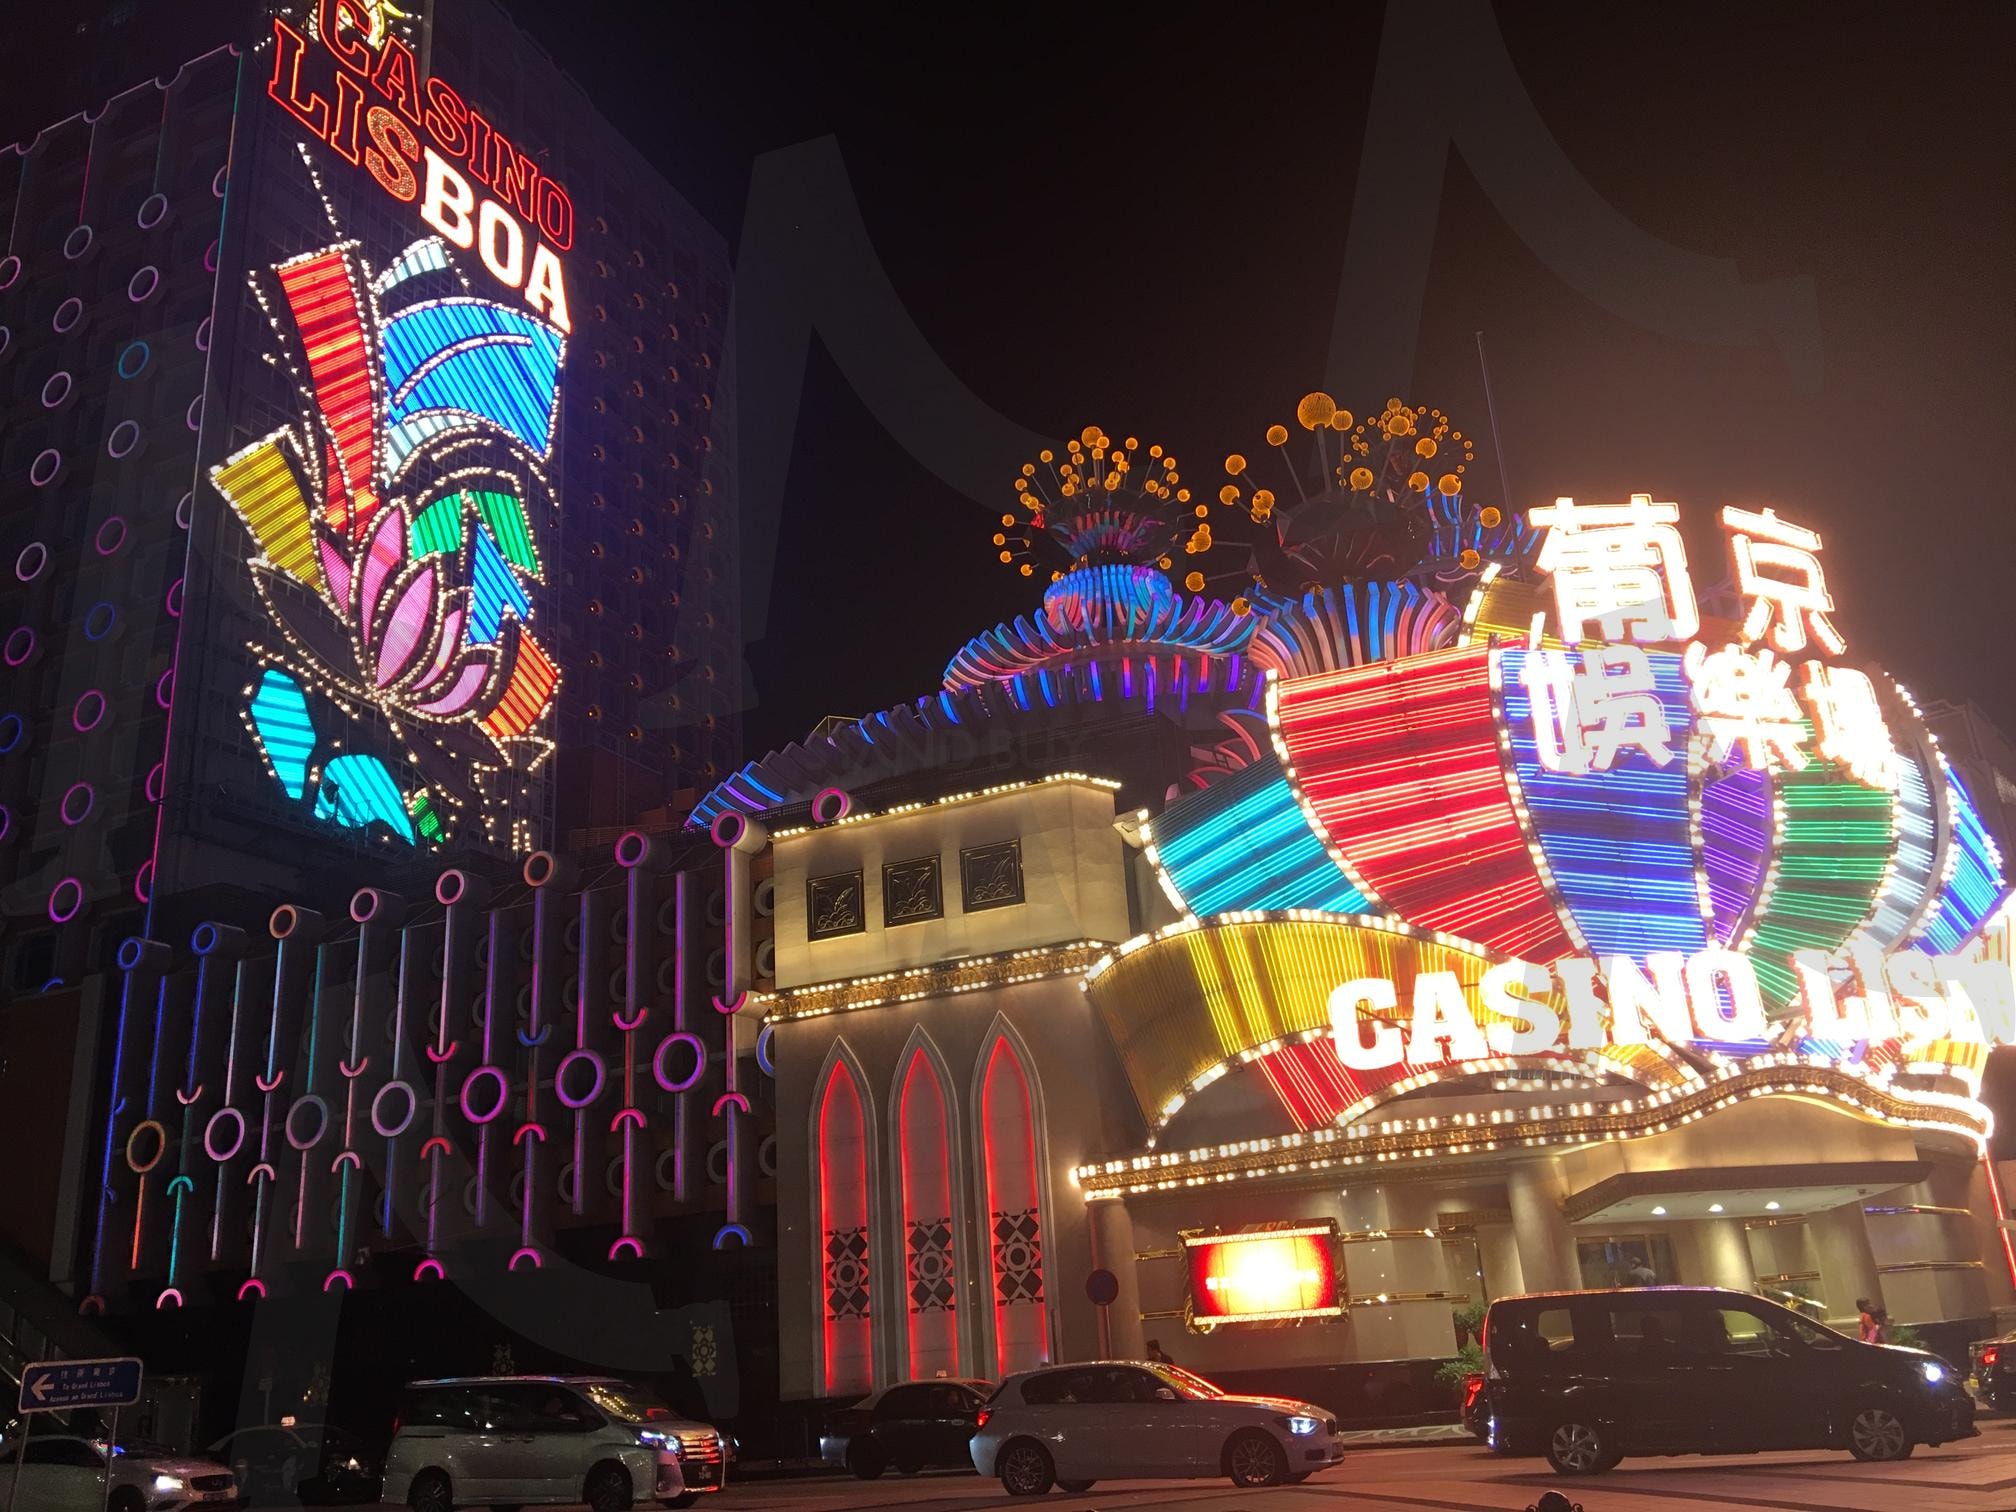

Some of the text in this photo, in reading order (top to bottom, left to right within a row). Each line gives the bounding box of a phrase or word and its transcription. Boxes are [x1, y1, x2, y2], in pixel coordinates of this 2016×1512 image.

[268, 18, 571, 334] LISBOA
[319, 0, 573, 250] CASINO
[1326, 948, 1770, 1071] CASINO
